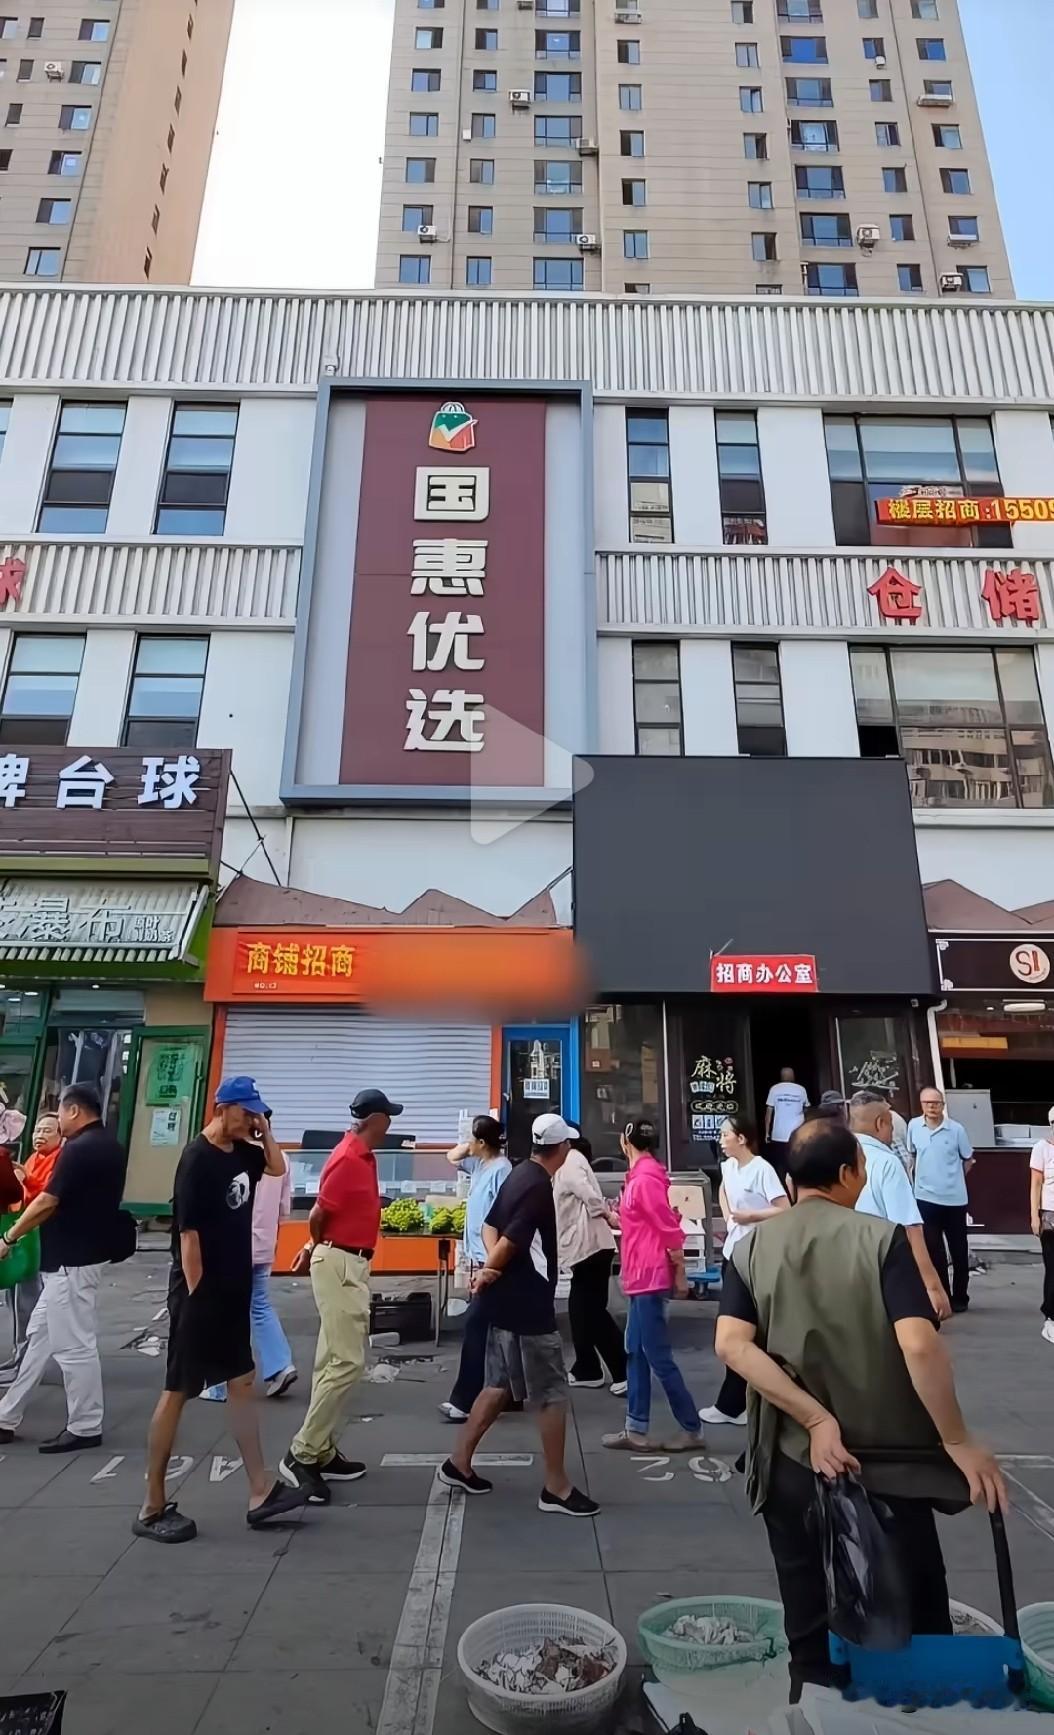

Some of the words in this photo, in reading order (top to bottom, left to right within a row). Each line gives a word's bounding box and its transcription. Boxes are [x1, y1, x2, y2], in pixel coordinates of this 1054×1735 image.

[404, 466, 491, 752] 国惠优选
[866, 566, 1041, 621] 仓储
[246, 942, 356, 977] 商铺招商
[715, 963, 813, 984] 招商办公室
[690, 1055, 737, 1095] 麻将
